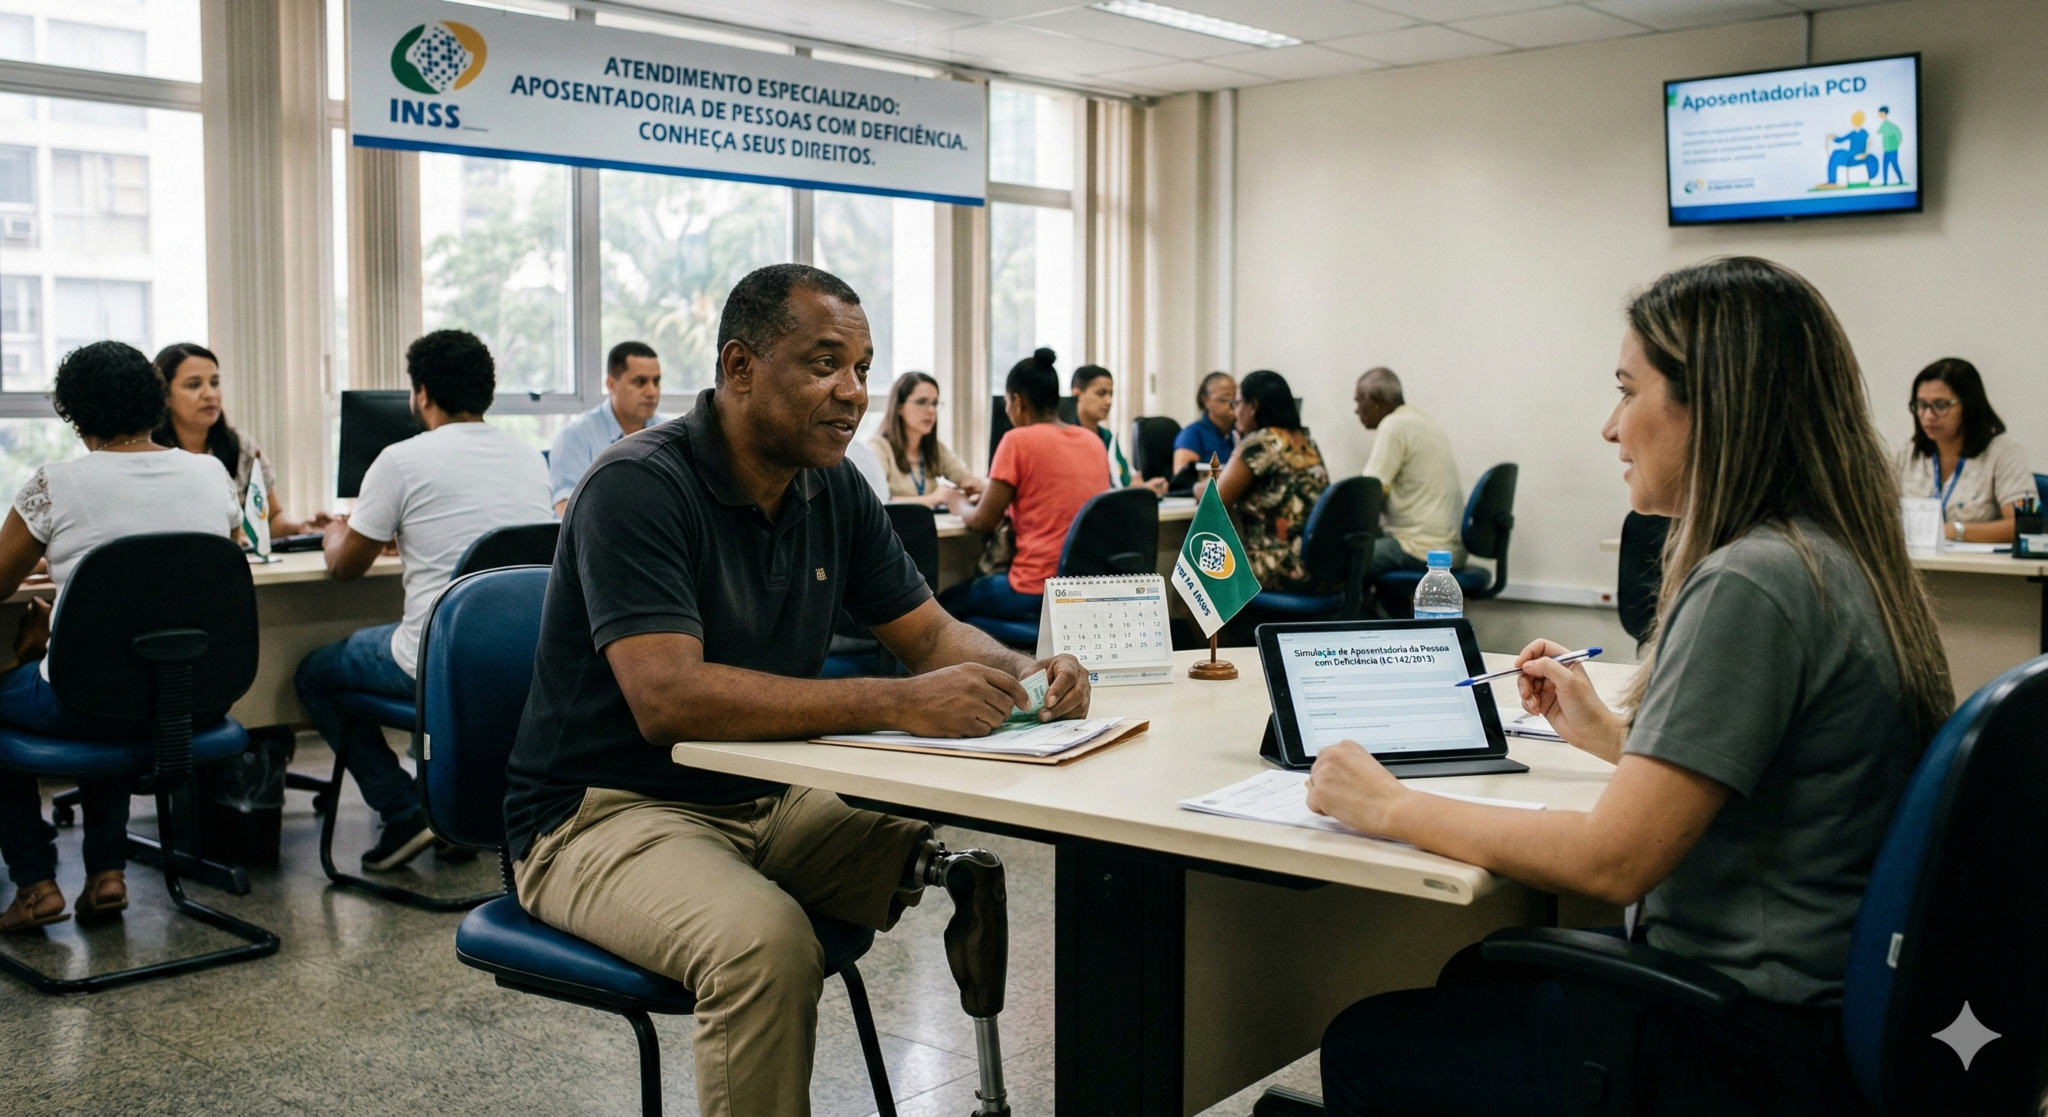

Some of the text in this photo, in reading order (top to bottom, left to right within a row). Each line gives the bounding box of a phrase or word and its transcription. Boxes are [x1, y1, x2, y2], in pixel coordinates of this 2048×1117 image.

[605, 56, 901, 116] ATENDIMENTO ESPECIALIZADO:
[1682, 76, 1867, 112] Aposentadoria PCD
[390, 98, 461, 129] INSS
[511, 75, 968, 151] APOSENTADORIA DE PESSOAS COM DEFICIÊNCIA.
[639, 122, 876, 166] CONHEÇA SEUS DIREITOS.
[1055, 589, 1066, 597] 06
[1294, 648, 1336, 659] Simulação
[1338, 648, 1348, 656] de
[1350, 646, 1407, 656] Aposentadoria
[1409, 645, 1419, 653] da
